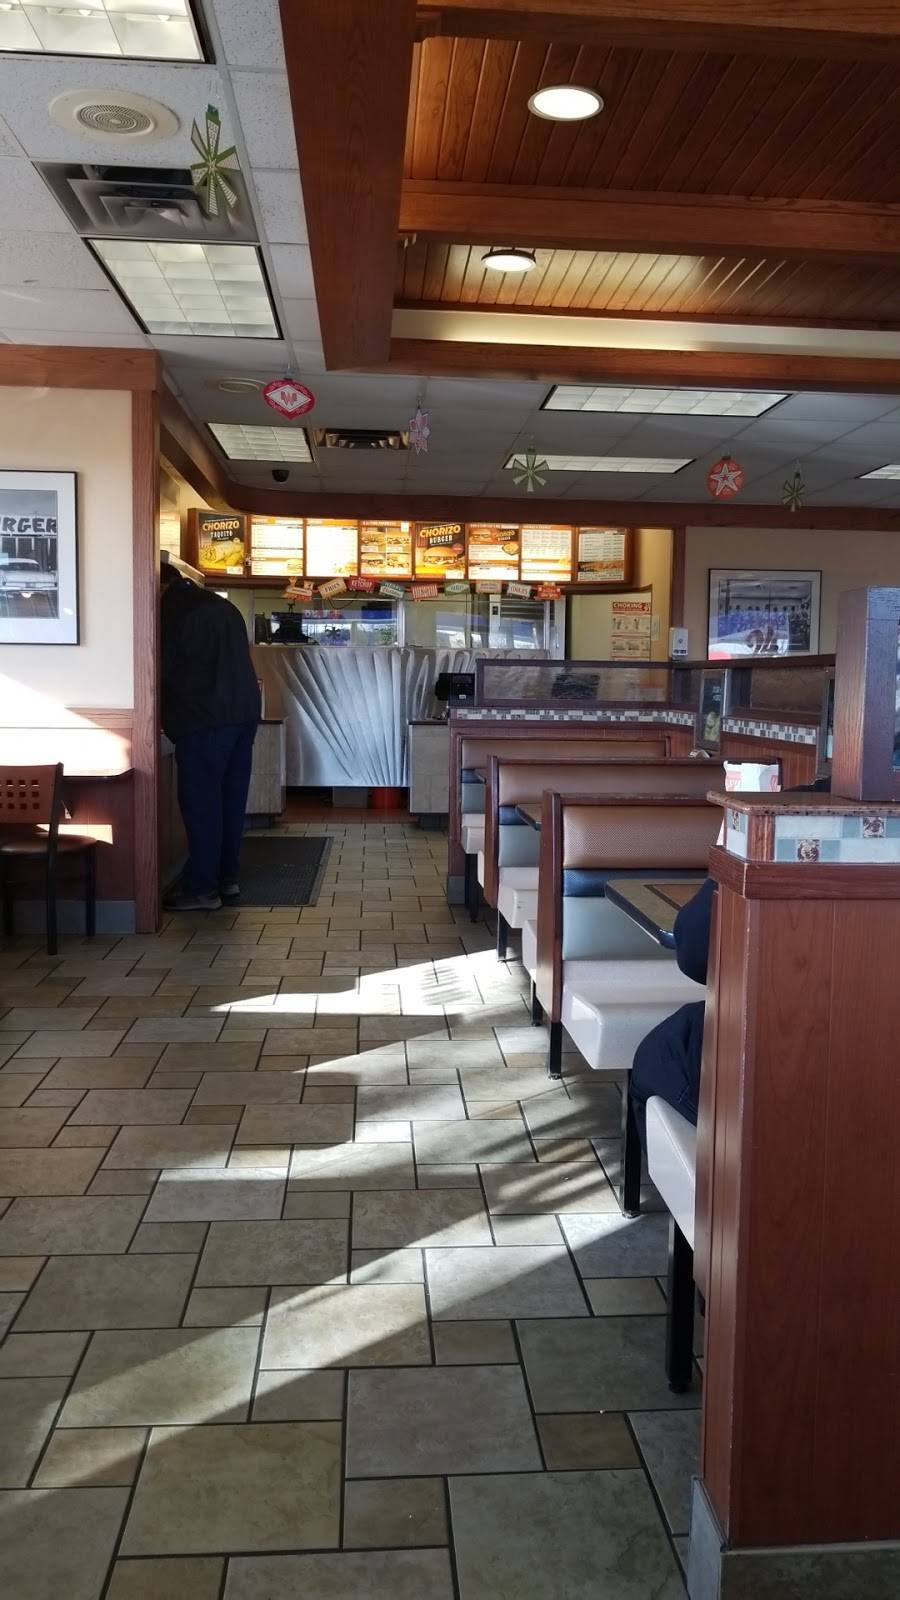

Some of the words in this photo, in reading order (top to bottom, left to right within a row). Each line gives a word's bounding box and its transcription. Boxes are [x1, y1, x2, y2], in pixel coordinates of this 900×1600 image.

[0, 516, 56, 533] RGER
[202, 520, 240, 532] CHORIZO
[419, 525, 461, 538] CHORIZO
[429, 534, 453, 545] BURGER
[613, 602, 641, 610] CHOKING
